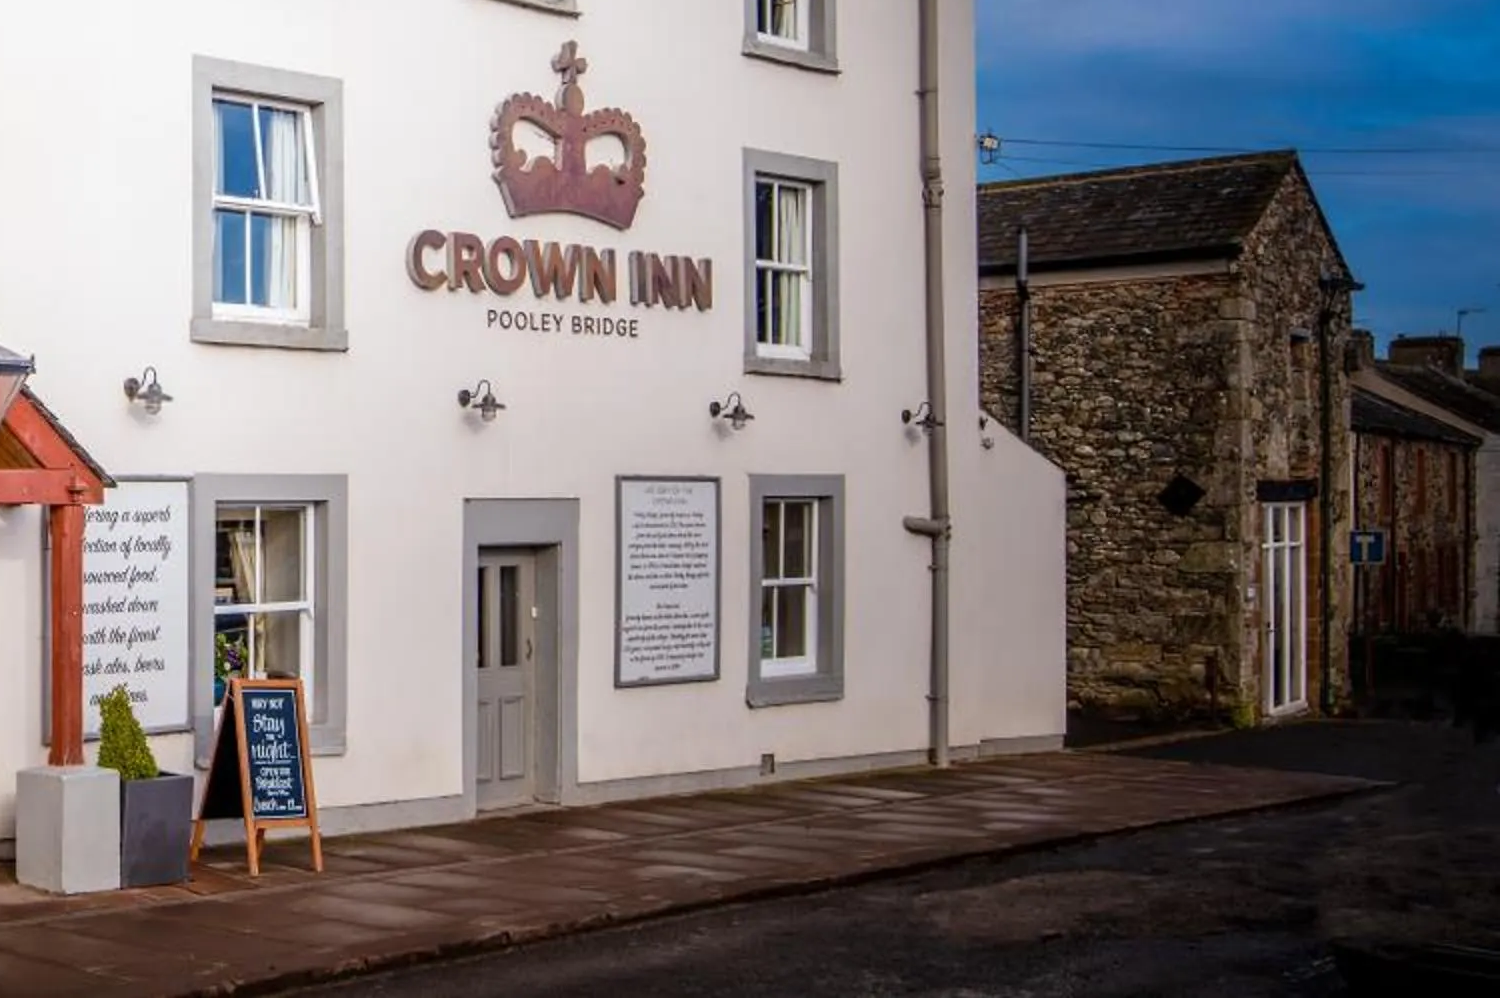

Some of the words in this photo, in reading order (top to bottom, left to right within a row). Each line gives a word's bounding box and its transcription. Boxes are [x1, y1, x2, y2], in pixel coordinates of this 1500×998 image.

[405, 229, 616, 303] CROWN
[628, 250, 713, 311] INN
[487, 310, 564, 333] POOLEY
[571, 315, 639, 338] BRIDGE
[132, 505, 171, 526] superb
[120, 536, 132, 559] of
[133, 535, 171, 560] locally
[127, 595, 159, 613] down
[108, 626, 126, 643] the
[83, 658, 102, 675] ask
[134, 654, 165, 672] beers
[253, 713, 285, 739] Stay
